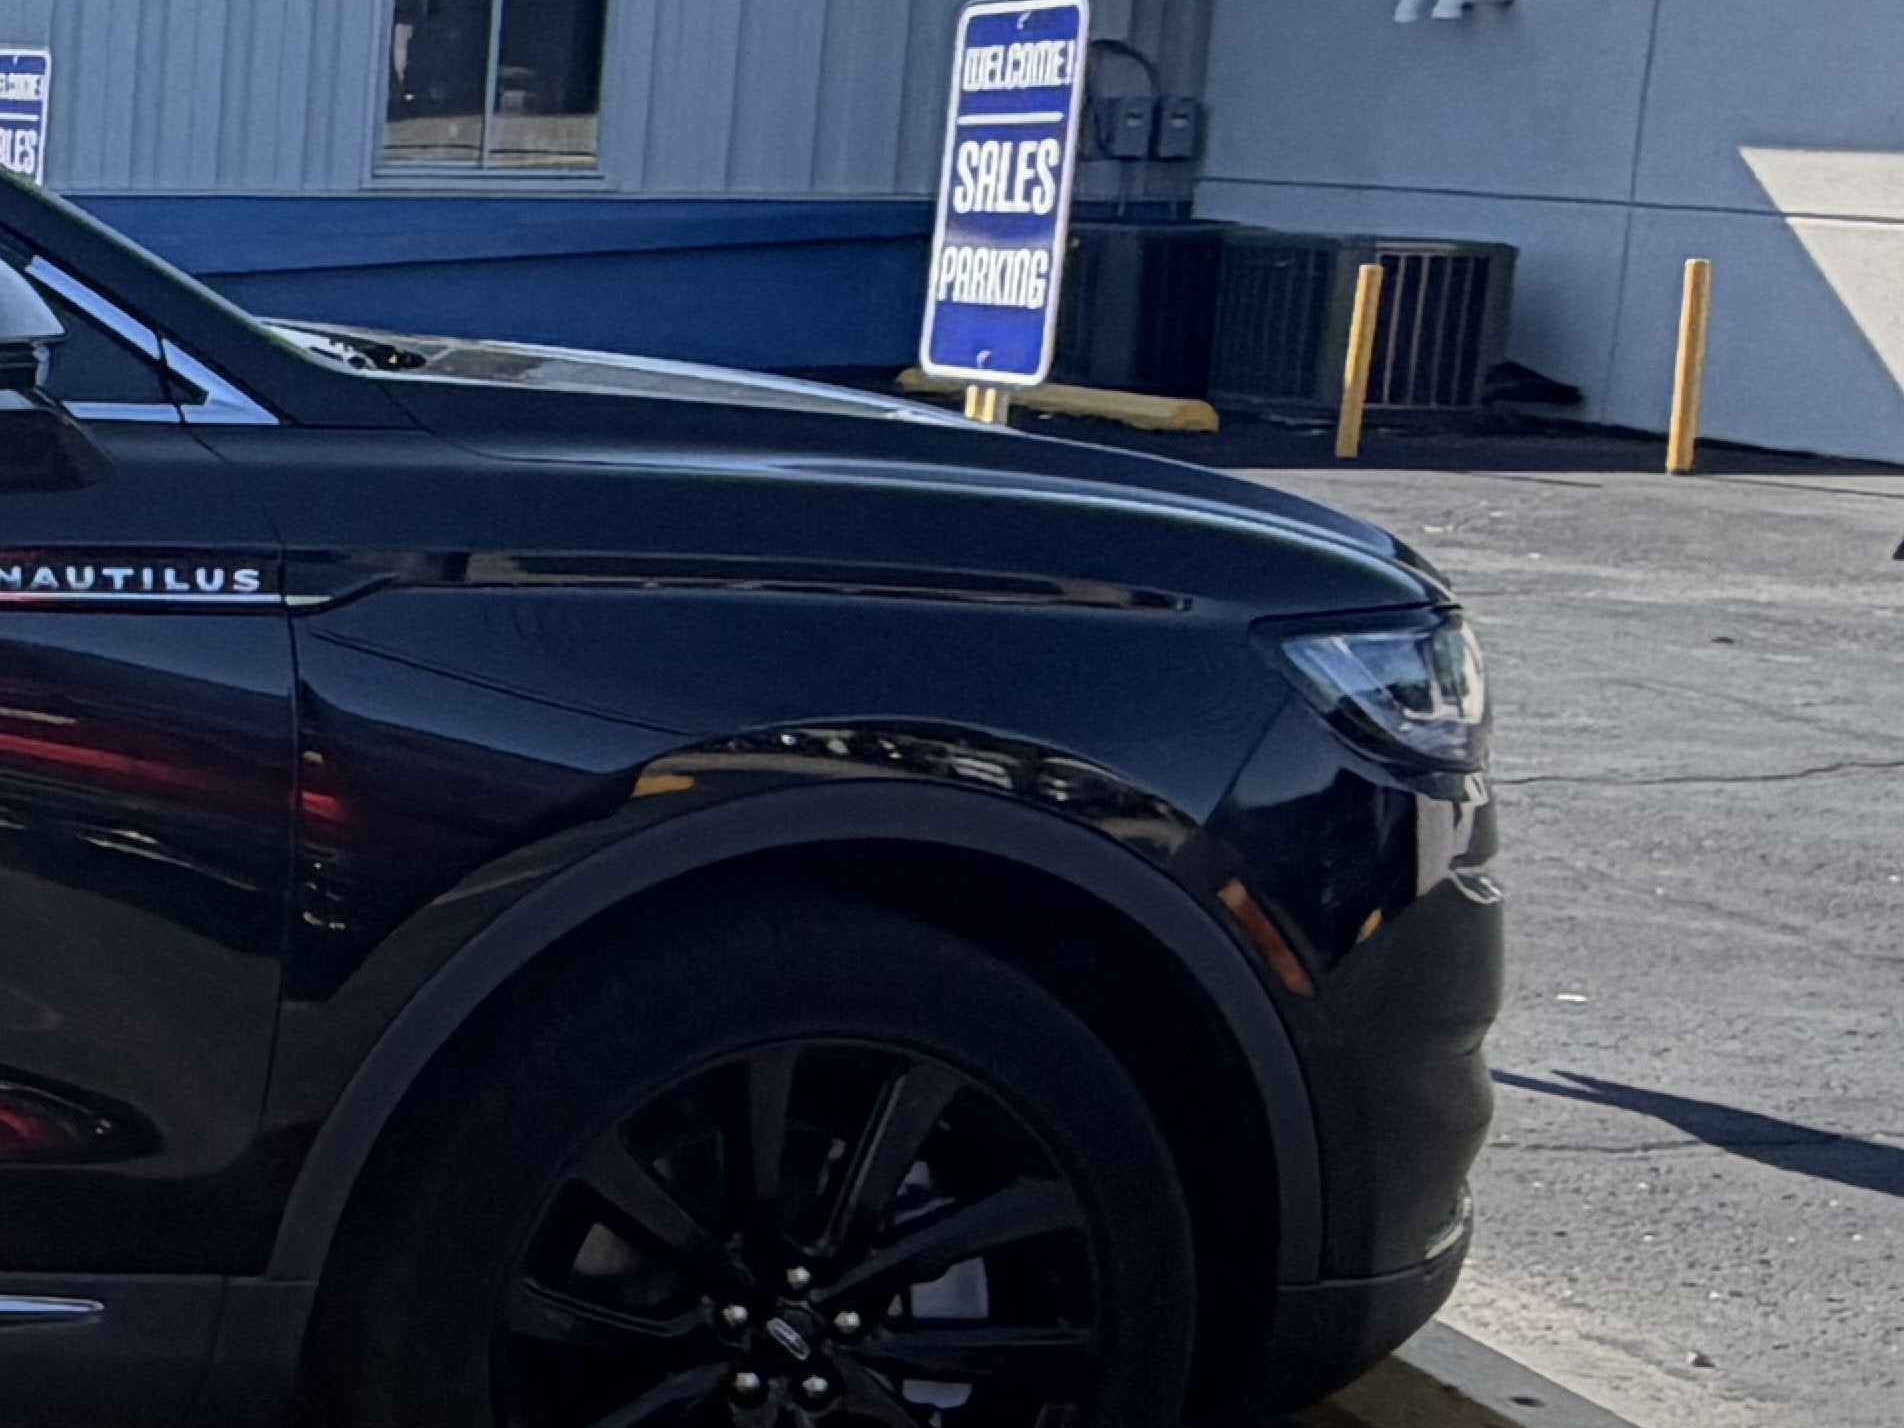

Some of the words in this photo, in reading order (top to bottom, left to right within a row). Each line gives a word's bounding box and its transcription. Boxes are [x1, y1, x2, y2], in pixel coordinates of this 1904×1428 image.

[962, 39, 1076, 92] WELCOME!
[953, 138, 1061, 215] SALES
[936, 245, 1050, 310] PARKING
